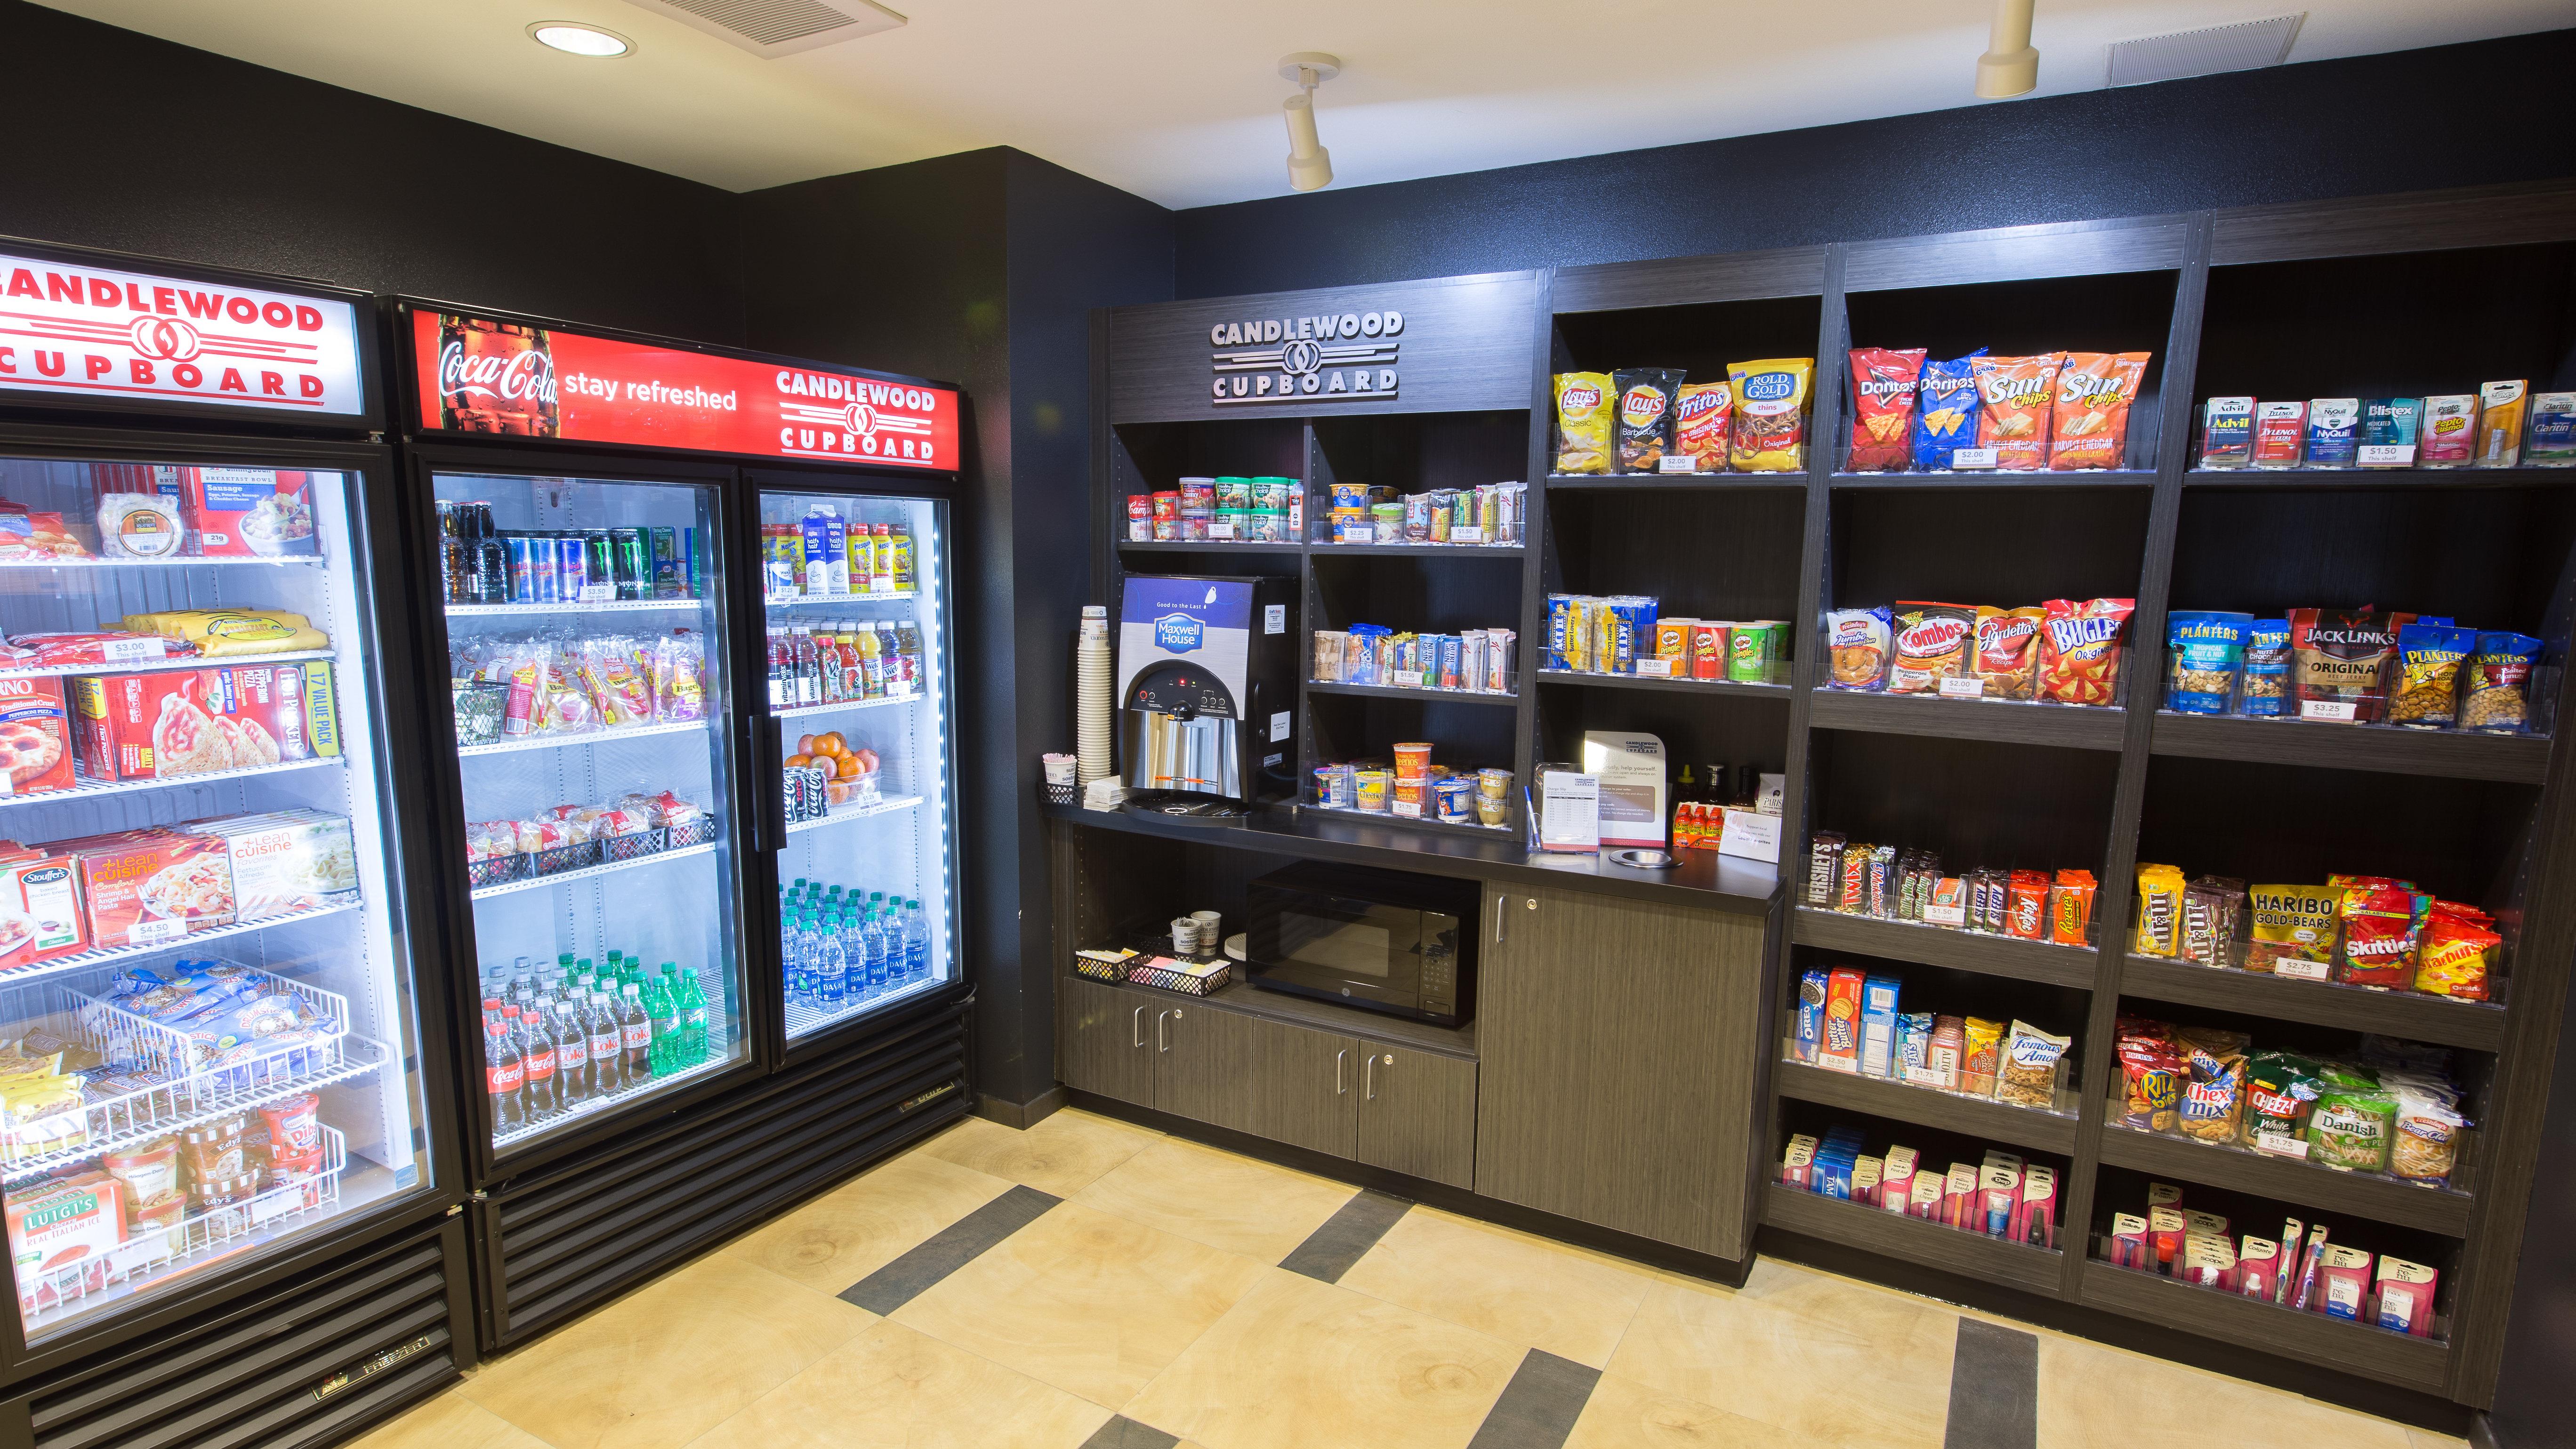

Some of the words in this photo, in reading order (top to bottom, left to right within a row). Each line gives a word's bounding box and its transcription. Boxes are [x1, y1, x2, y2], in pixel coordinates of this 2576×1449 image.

[0, 268, 323, 332] ANDLEWOOD
[1211, 310, 1404, 346] CANDLEWOOD
[438, 341, 558, 407] Coca-Cola
[1753, 373, 1789, 385] ROLD
[1213, 369, 1398, 398] CUPBOARD
[1747, 382, 1790, 399] GOLD
[1861, 380, 1916, 396] Doritos
[1921, 377, 1975, 392] Doritos
[1986, 376, 2045, 404] Sun
[2060, 375, 2123, 403] Sun
[564, 371, 615, 402] stay
[627, 380, 737, 412] refreshed
[776, 370, 935, 412] CANDLEWOOD
[1623, 396, 1664, 415] Lay's
[1678, 390, 1724, 417] Fritos
[2011, 389, 2051, 410] Chips
[2085, 390, 2124, 410] Chips
[2368, 405, 2414, 417] Blistex
[1565, 419, 1592, 427] Classic
[2212, 418, 2249, 428] Advil
[2434, 418, 2465, 429] Pepto-
[2436, 424, 2464, 435] Bismol
[2535, 424, 2568, 432] Claritin
[1622, 427, 1656, 436] Barbecue
[2317, 429, 2350, 438] NyQuil
[780, 427, 934, 460] CUPBOARD
[1763, 437, 1791, 448] Original
[2054, 440, 2079, 451] HARVEST
[2081, 438, 2113, 449] CHEDDAR
[207, 484, 243, 493] Sausage
[1158, 622, 1199, 636] Maxwell
[1901, 622, 1964, 648] Combos
[1977, 619, 2039, 651] Gardetto's
[2181, 626, 2238, 641] PLANTERS
[2305, 628, 2346, 644] JACK
[2347, 628, 2397, 644] LINK'S
[1161, 633, 1195, 645] House
[1834, 632, 1867, 646] Jumbo
[115, 643, 145, 652] $3.00
[1660, 643, 1682, 656] Pringles
[1732, 647, 1755, 660] Pringles
[2407, 650, 2467, 663] PLANTERS
[310, 672, 326, 686] 17
[1898, 668, 1927, 676] Pepperoni
[676, 683, 699, 692] Bagel
[312, 689, 330, 718] VALUE
[2314, 703, 2340, 711] $3.25
[8, 710, 37, 718] PEPPERONI
[317, 720, 333, 745] PACK
[1359, 791, 1384, 799] Cheerios
[256, 831, 290, 846] Lean
[116, 853, 159, 869] Lean
[27, 868, 65, 883] Stouffer's
[238, 871, 265, 879] Alfredo
[1808, 843, 1832, 903] HERSHEY'S
[95, 879, 135, 891] Comfort
[1842, 861, 1861, 908] TWIX
[97, 896, 120, 905] Angel
[98, 903, 119, 911] Pasta
[2255, 894, 2333, 916] HARIBO
[2059, 894, 2074, 935] Reese's
[2255, 913, 2332, 930] GOLD-BEARS
[140, 924, 169, 934] $4.50
[2346, 939, 2417, 958] Skittles
[2286, 962, 2311, 971] $2.75
[1803, 1006, 1814, 1040] OREO
[623, 1028, 651, 1042] Coke
[590, 1038, 620, 1053] Coke
[2010, 1036, 2061, 1055] Famous
[555, 1047, 586, 1063] Coke
[1827, 1057, 1845, 1065] $2.50
[1915, 1070, 1934, 1078] $1.75
[2013, 1063, 2034, 1071] Chocolate
[2143, 1073, 2176, 1098] RITZ
[2187, 1083, 2230, 1103] Chex
[2188, 1102, 2228, 1118] mix
[2260, 1119, 2290, 1130] White
[2322, 1114, 2377, 1136] Danish
[2269, 1137, 2294, 1147] $1.75
[1955, 1181, 1970, 1189] Emery
[2153, 1192, 2177, 1201] Foamy
[27, 1197, 94, 1230] LUIGI'S
[2156, 1221, 2180, 1231] Foamy
[2194, 1218, 2218, 1230] scope
[27, 1237, 48, 1247] REAL
[52, 1223, 84, 1239] ITALIAN
[88, 1216, 101, 1226] ICE
[2248, 1245, 2272, 1255] Colgate
[2200, 1255, 2225, 1267] scope
